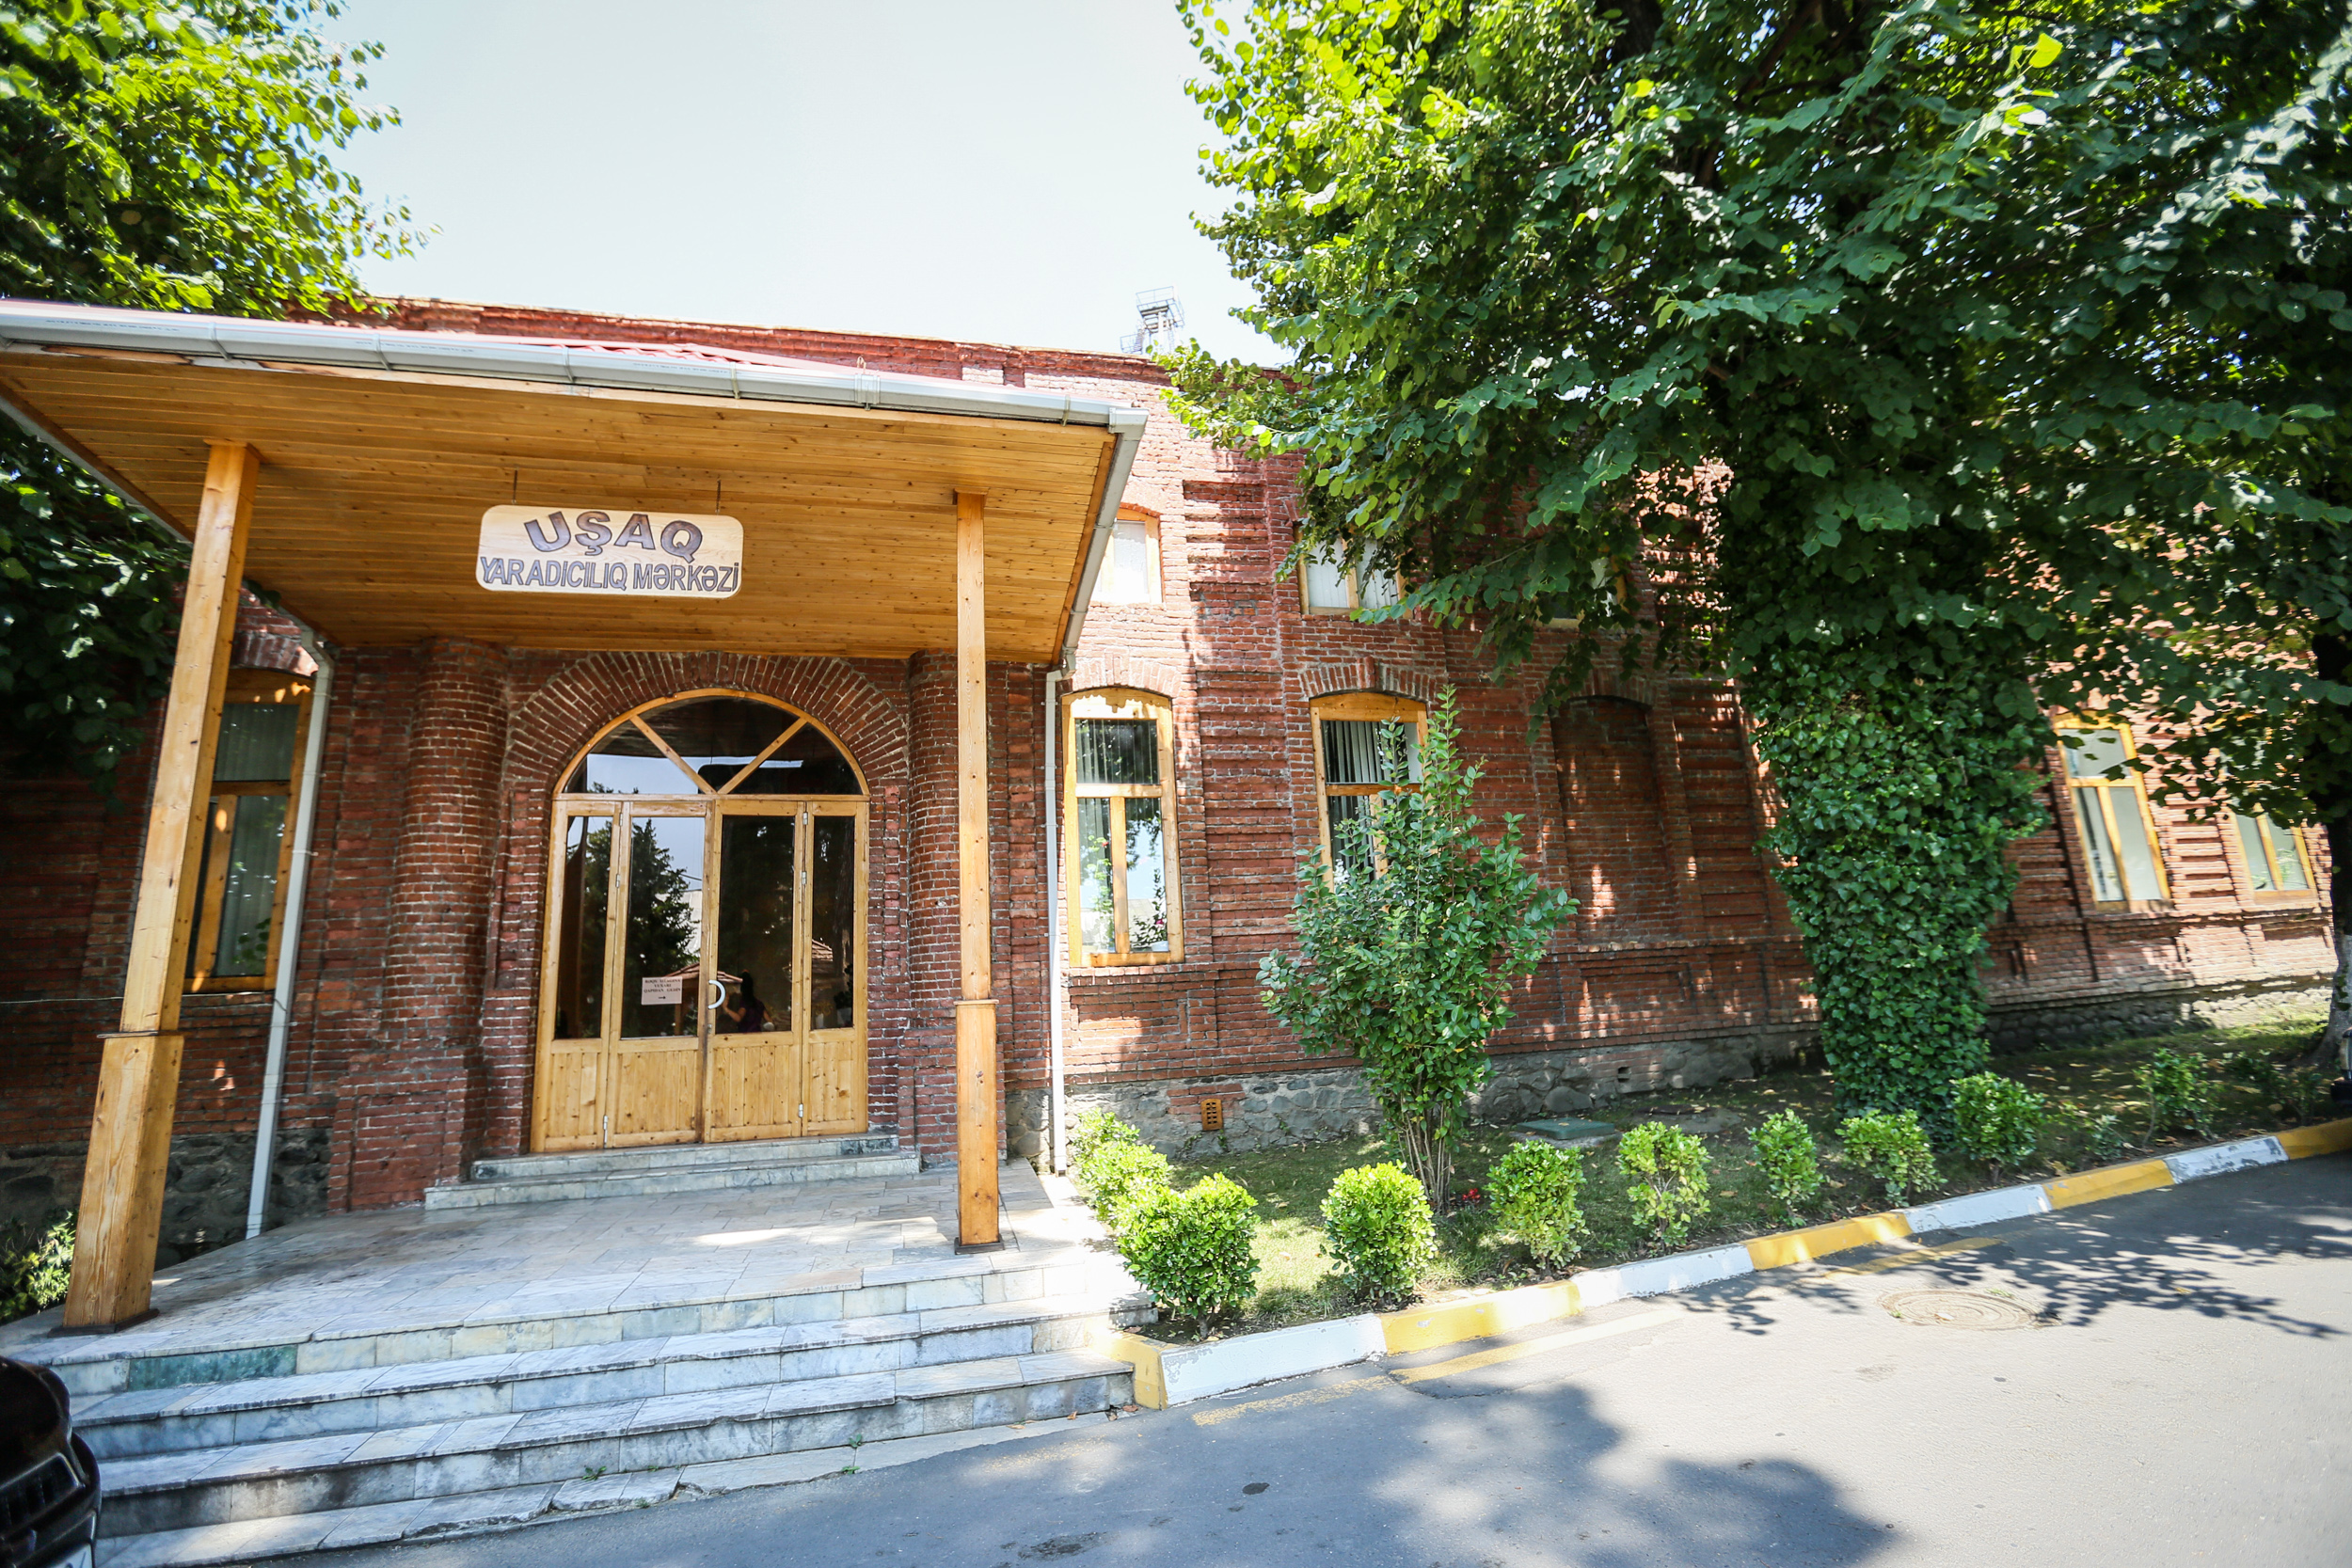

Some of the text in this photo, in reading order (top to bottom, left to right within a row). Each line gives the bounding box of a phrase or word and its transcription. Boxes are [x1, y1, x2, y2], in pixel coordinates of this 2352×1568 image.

[524, 511, 703, 563] UŞAQ
[480, 556, 739, 592] YARADICILIQ MƏRKƏZİ
